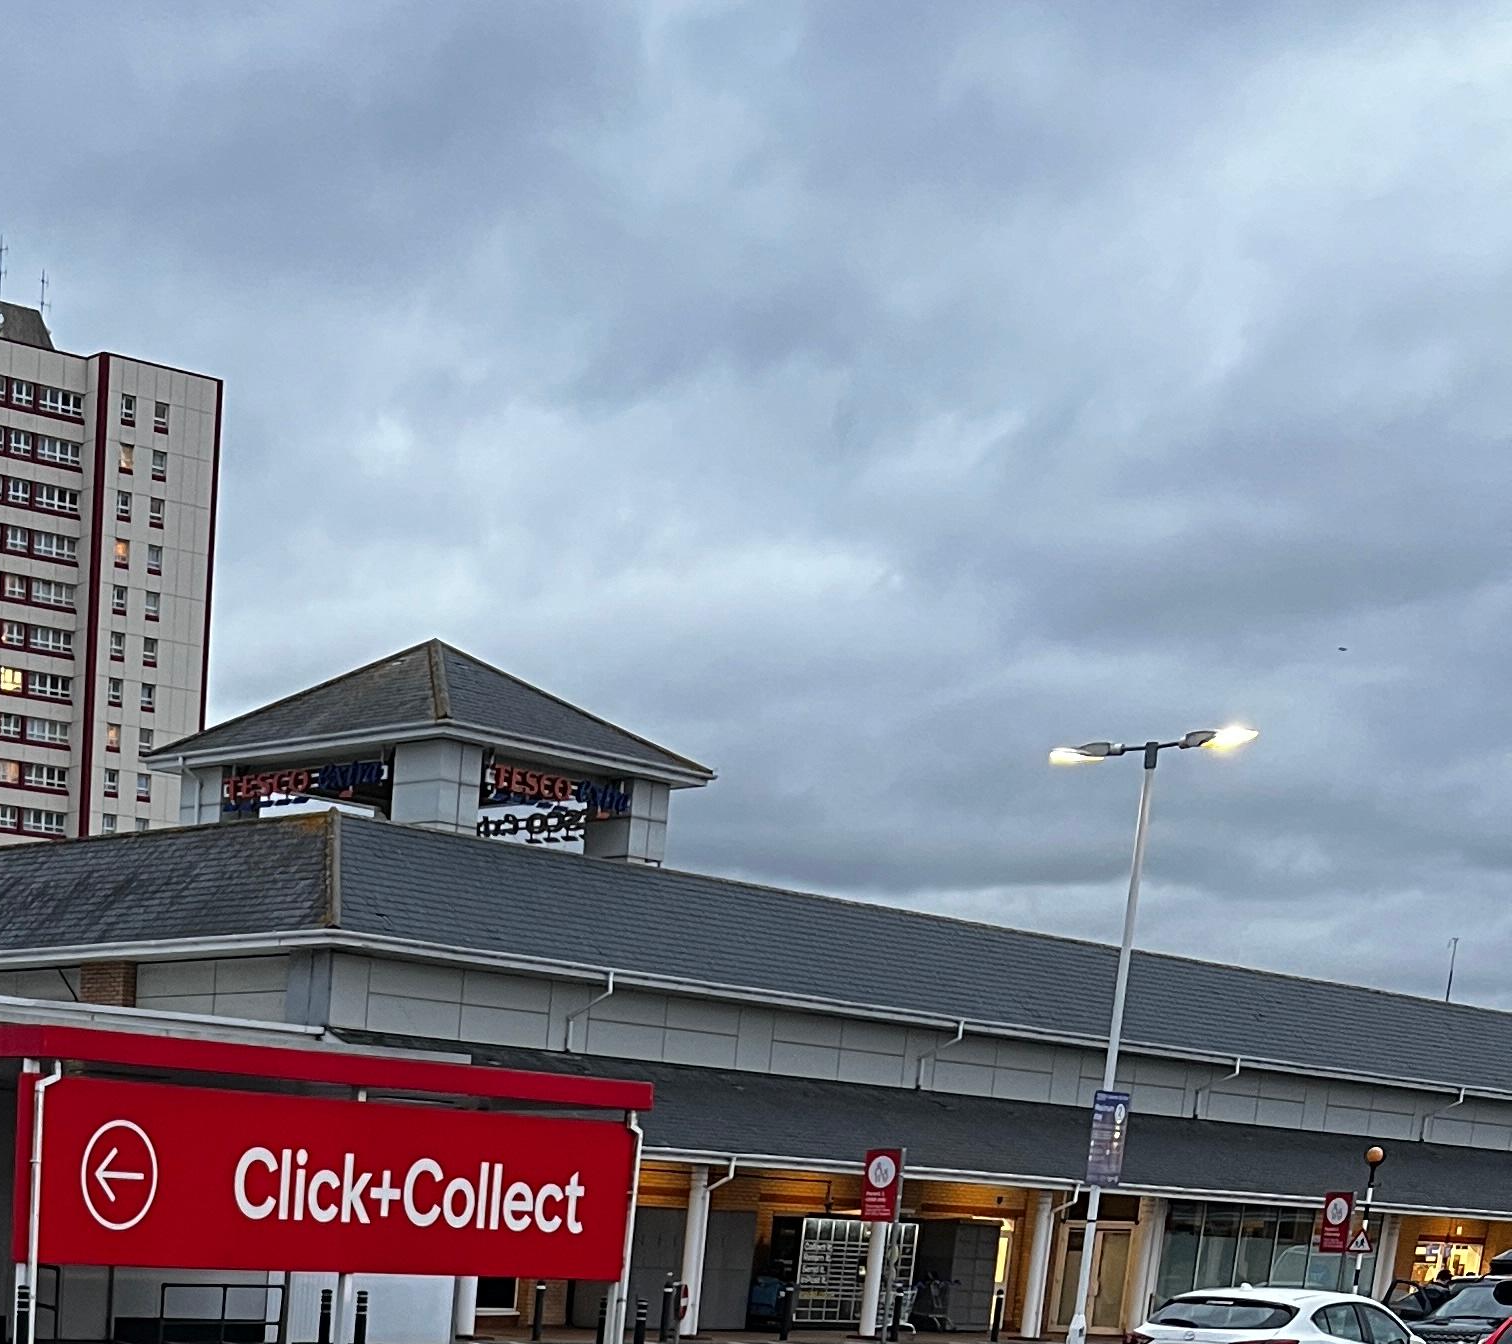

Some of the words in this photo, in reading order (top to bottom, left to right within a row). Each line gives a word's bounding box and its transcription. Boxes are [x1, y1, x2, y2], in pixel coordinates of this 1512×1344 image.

[223, 768, 312, 802] TESCO
[494, 764, 572, 801] TESCO
[233, 1146, 585, 1235] Click+Collect
